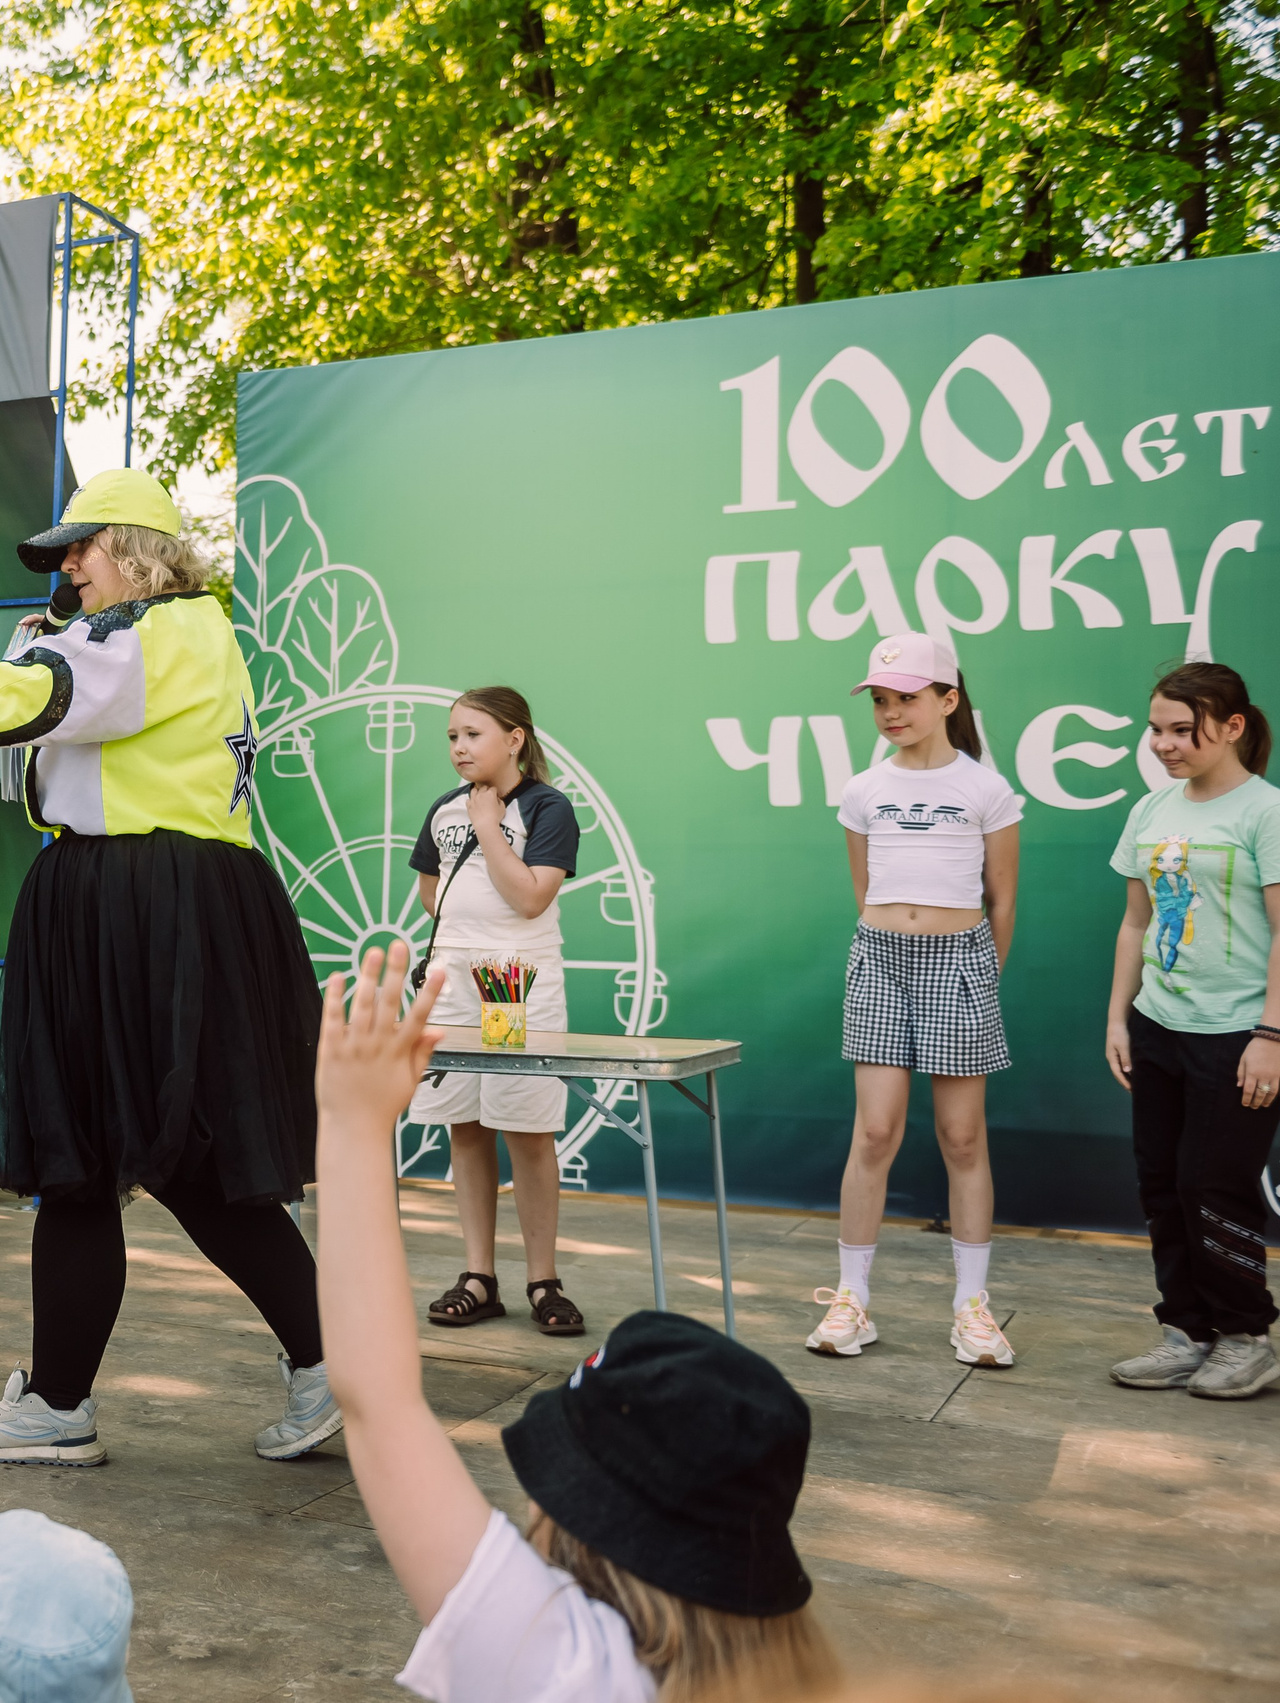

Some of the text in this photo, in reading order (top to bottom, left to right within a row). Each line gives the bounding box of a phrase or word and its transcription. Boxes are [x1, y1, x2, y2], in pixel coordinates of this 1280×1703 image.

[719, 333, 1272, 513] 100 ЛЕТ
[704, 519, 1263, 670] ПАРКУ
[925, 812, 969, 825] JEANS
